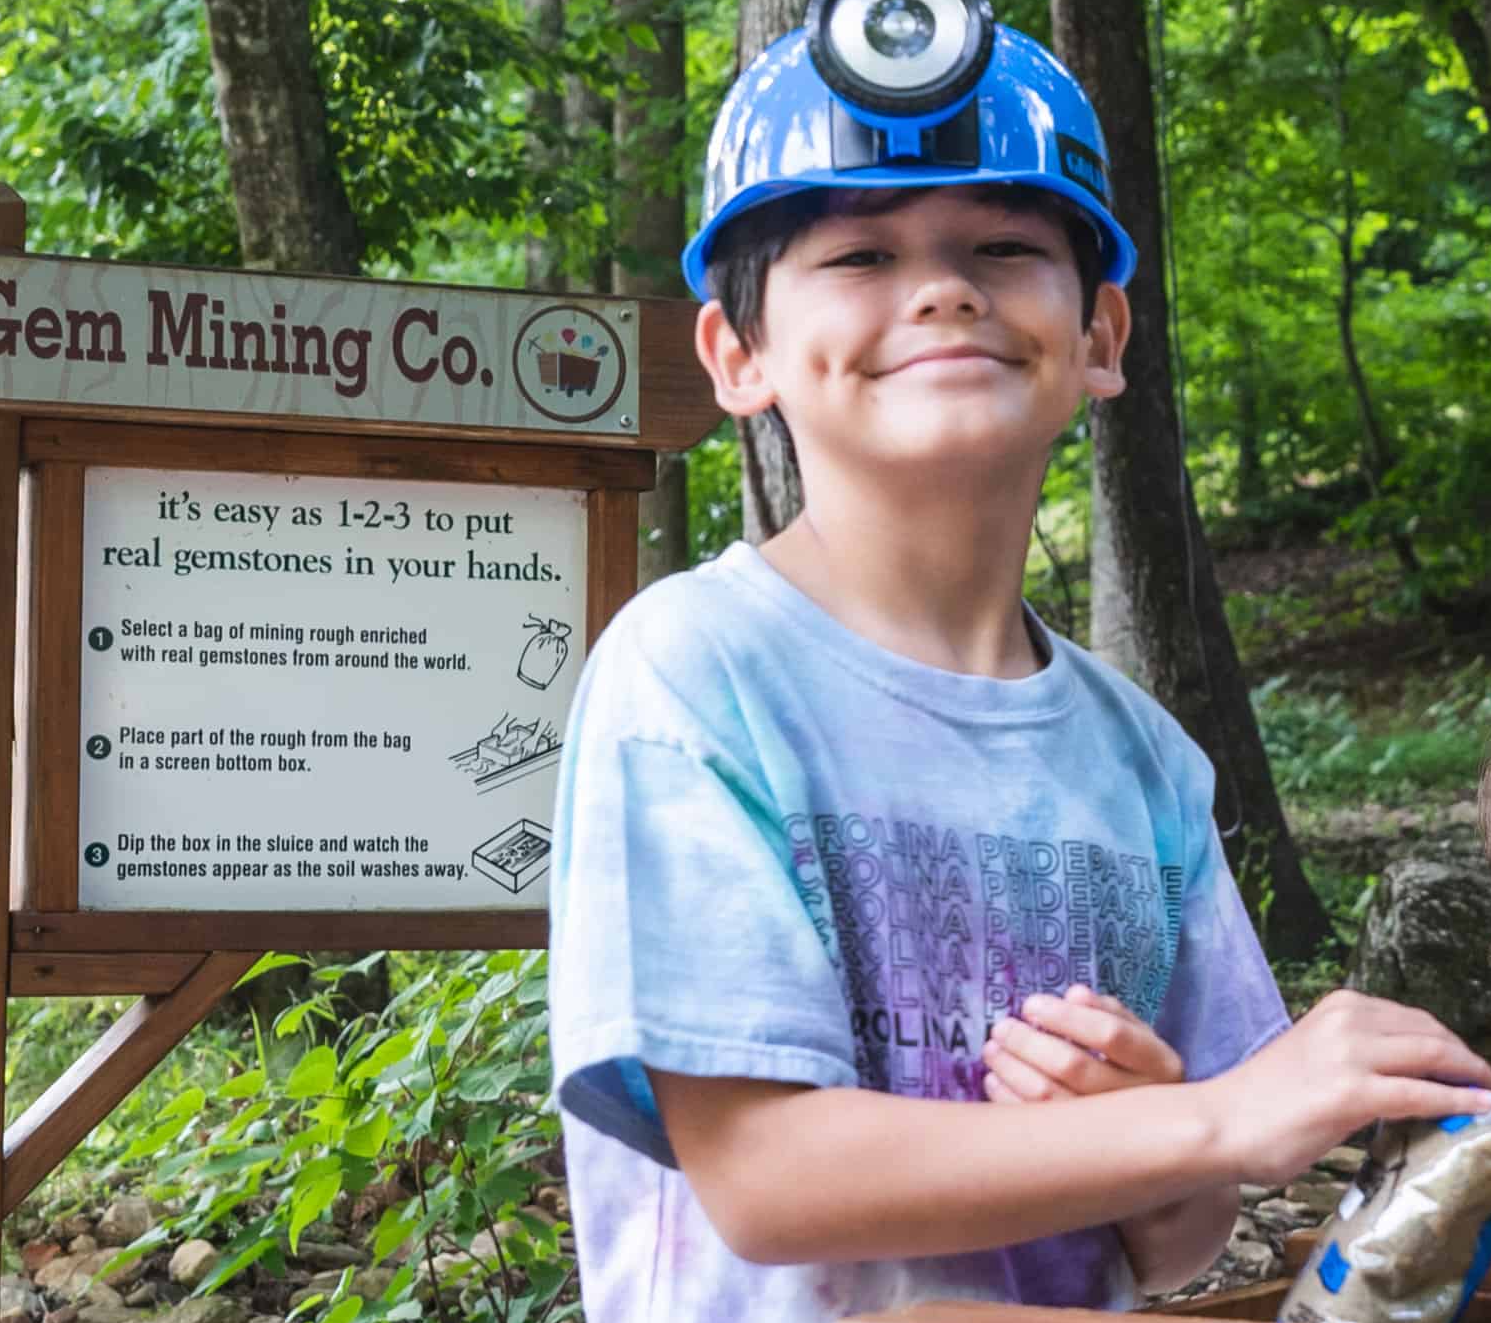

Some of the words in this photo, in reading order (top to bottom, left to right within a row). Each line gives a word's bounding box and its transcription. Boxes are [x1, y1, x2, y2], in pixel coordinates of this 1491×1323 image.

[146, 289, 372, 399] Mining
[392, 307, 495, 388] Co.
[214, 504, 280, 531] easy
[292, 507, 322, 525] as
[340, 500, 410, 529] 1-2-3
[425, 509, 453, 531] to
[466, 509, 513, 540] put
[103, 537, 161, 567] real
[175, 542, 332, 575] gemstones
[346, 547, 373, 575] in
[388, 553, 455, 583] your
[468, 550, 561, 581] hands.
[122, 619, 172, 637] Select
[179, 625, 187, 637] a
[194, 621, 222, 642] bag
[229, 623, 244, 639] of
[250, 624, 303, 644] mining
[310, 626, 354, 645] rough
[361, 627, 426, 644] enriched
[121, 645, 155, 661] with
[162, 646, 192, 663] real
[200, 649, 287, 667] gemstones
[293, 649, 329, 666] from
[336, 653, 388, 668] around
[395, 653, 418, 669] the
[424, 654, 470, 670] world.
[120, 727, 164, 744] Place
[171, 729, 203, 748] part
[210, 729, 224, 745] of
[230, 729, 254, 745] the
[261, 730, 305, 750] rough
[312, 730, 347, 747] from
[354, 731, 377, 747] the
[384, 732, 410, 752] bag
[120, 752, 133, 769] in
[140, 757, 149, 769] a
[156, 757, 209, 770] screen
[216, 754, 271, 771] bottom
[279, 755, 310, 771] box.
[118, 834, 144, 855] Dip
[151, 835, 175, 851] the
[183, 835, 210, 851] box
[217, 835, 230, 851] in
[237, 835, 261, 851] the
[267, 835, 313, 851] sluice
[320, 836, 347, 852] and
[354, 836, 399, 852] watch
[405, 836, 428, 852] the
[782, 812, 969, 864] CROLINA
[117, 861, 206, 880] gemstones
[213, 864, 268, 880] appear
[274, 864, 291, 877] as
[298, 861, 321, 877] the
[327, 861, 354, 877] soil
[361, 861, 419, 877] washes
[425, 864, 468, 880] away.
[795, 851, 972, 903] CROLINA
[853, 1007, 970, 1055] ROLINA
